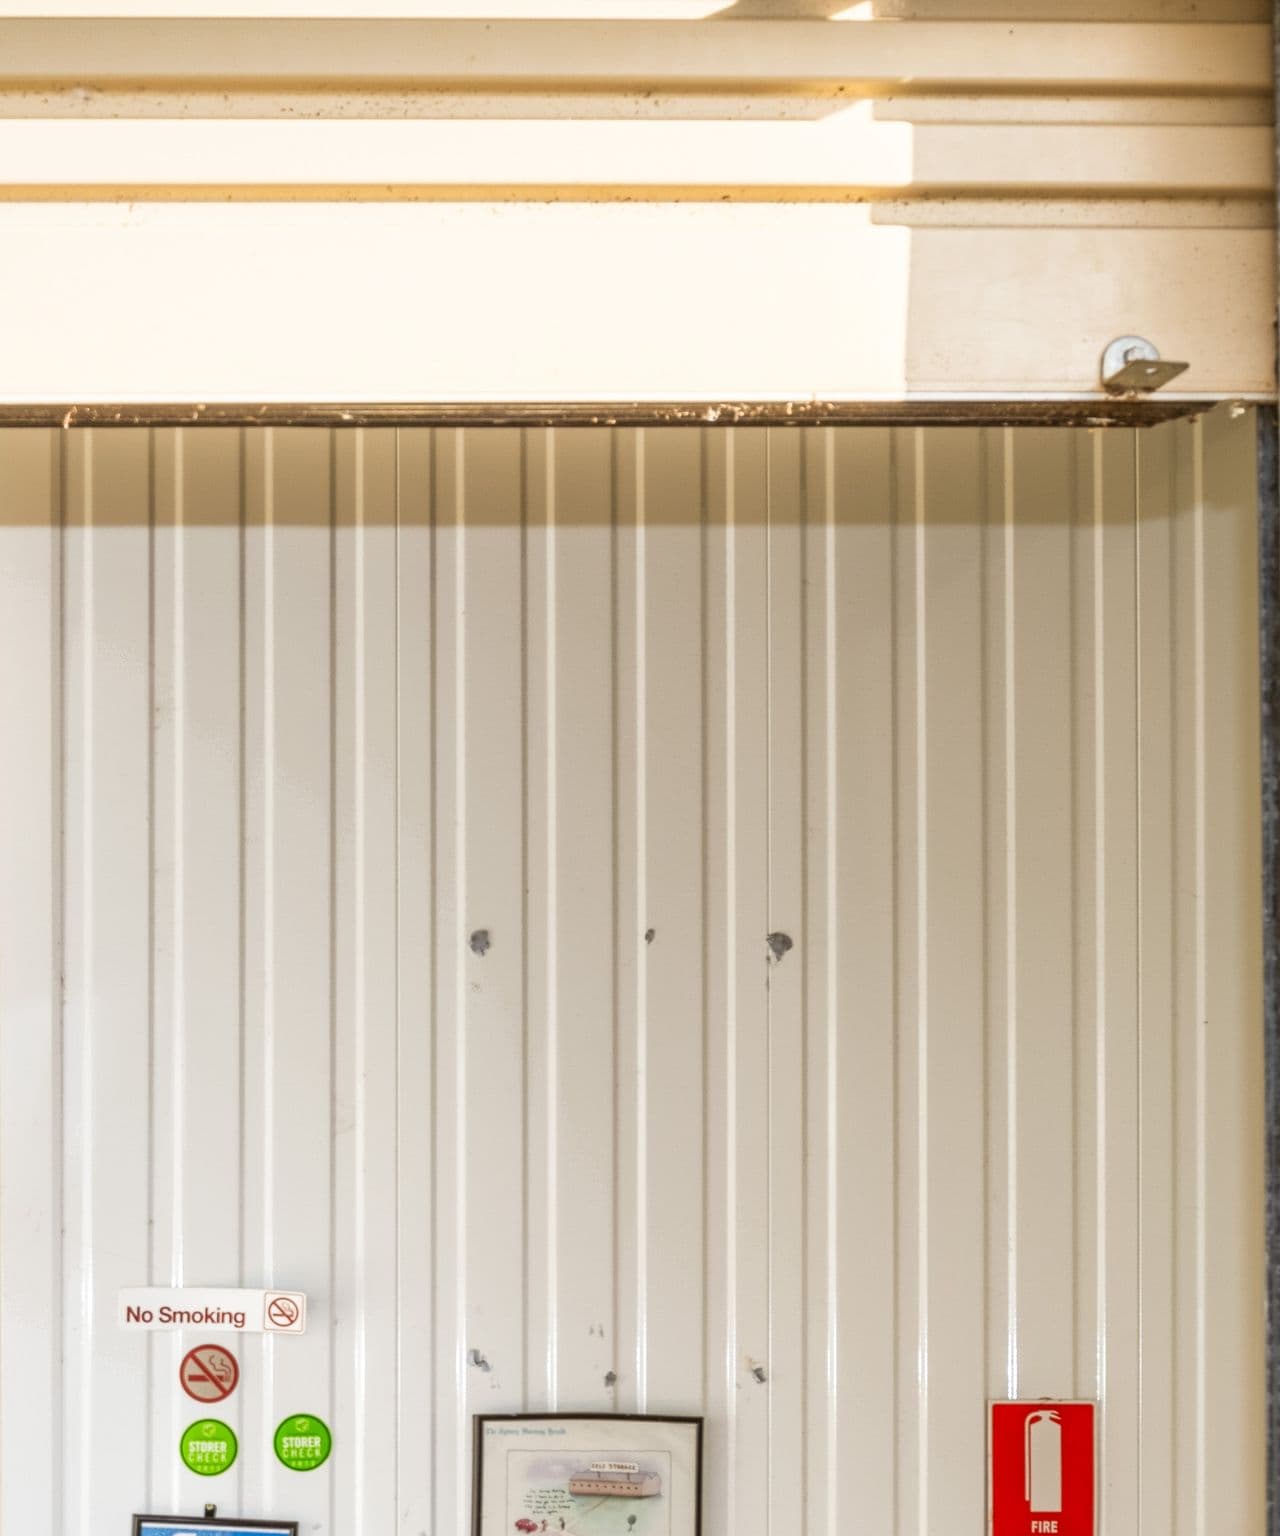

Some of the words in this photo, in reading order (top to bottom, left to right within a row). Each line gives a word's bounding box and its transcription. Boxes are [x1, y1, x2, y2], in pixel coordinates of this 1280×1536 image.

[126, 1306, 153, 1323] No
[159, 1306, 246, 1328] Smoking
[188, 1440, 227, 1454] STORER
[282, 1436, 321, 1449] STORER
[188, 1453, 227, 1464] CHECK
[282, 1448, 321, 1459] CHECK
[1031, 1521, 1058, 1533] FIRE
